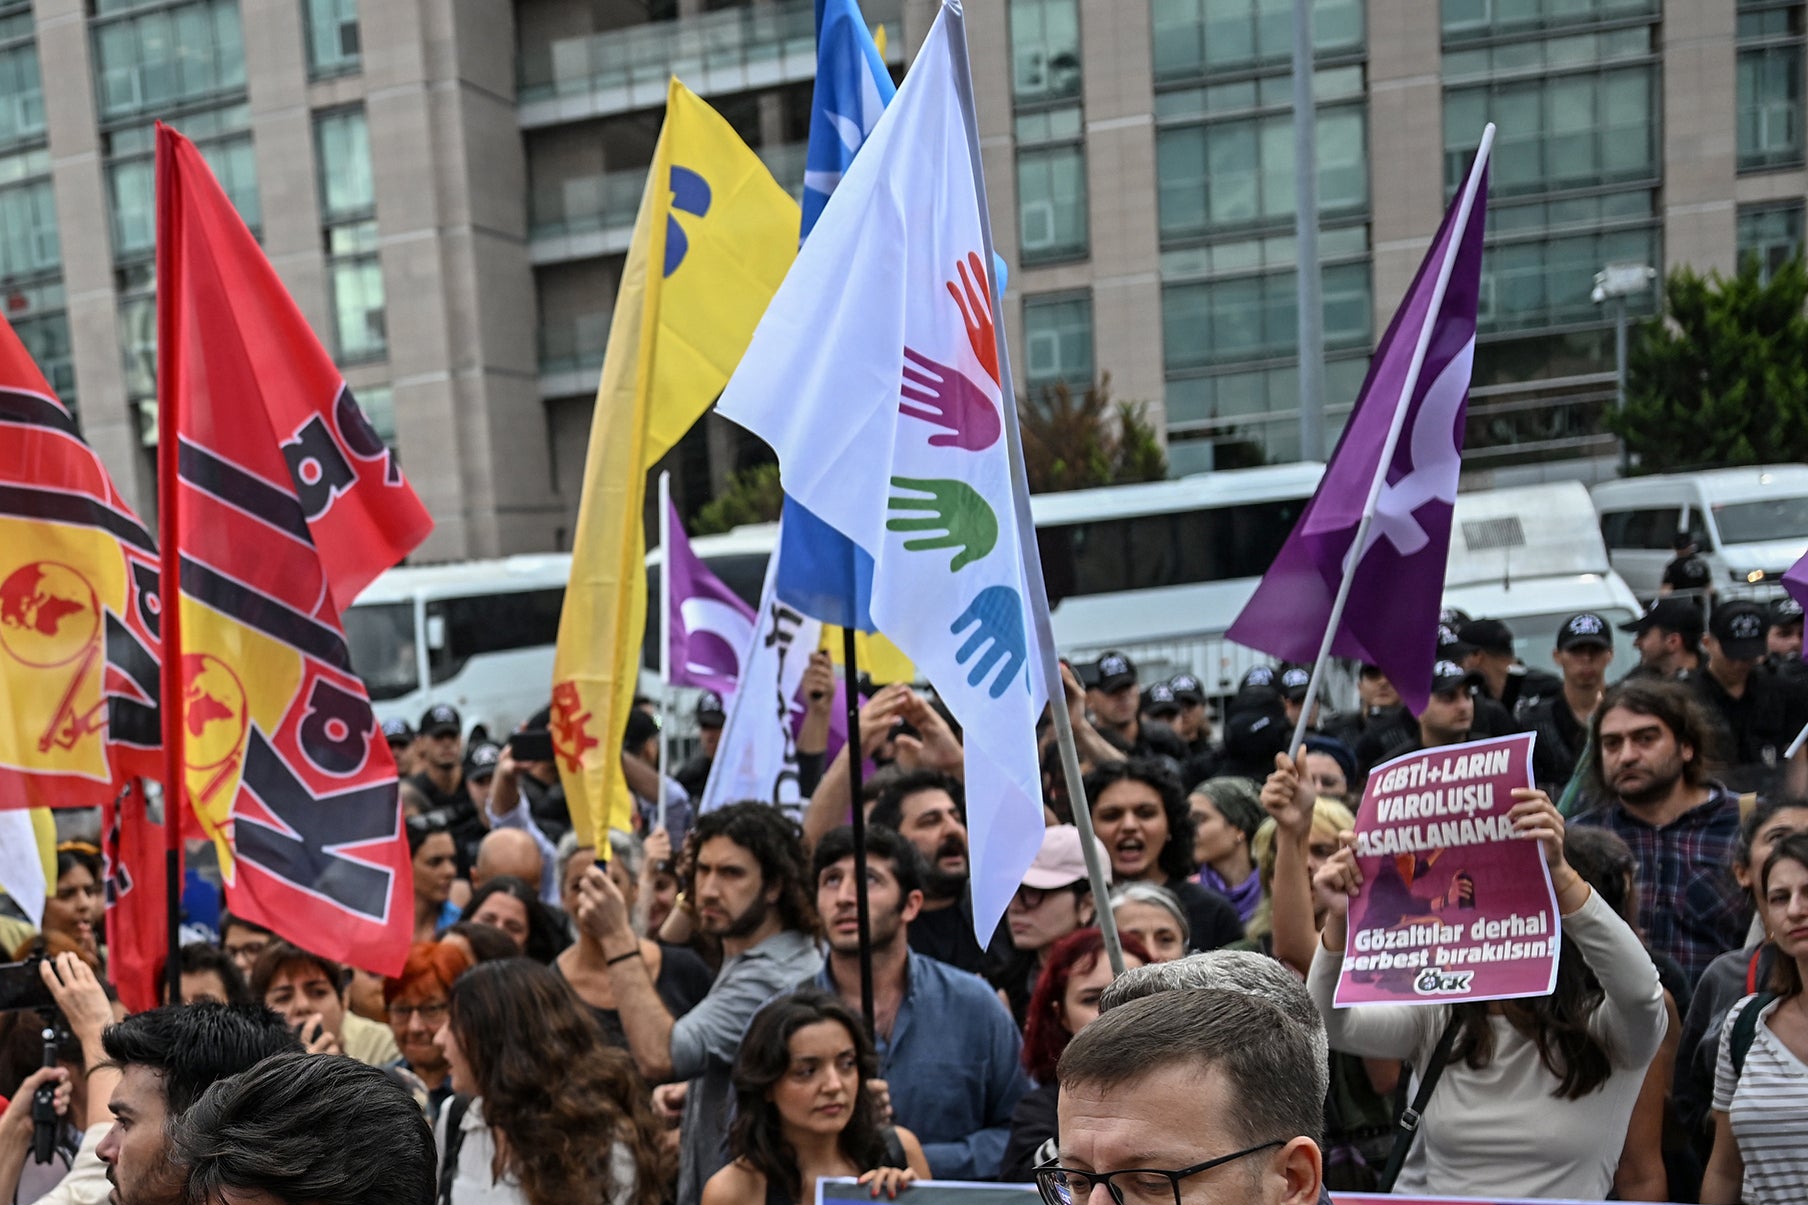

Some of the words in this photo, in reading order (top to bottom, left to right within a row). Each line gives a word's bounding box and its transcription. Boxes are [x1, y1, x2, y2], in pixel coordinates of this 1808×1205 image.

[1372, 748, 1510, 798] LGBTİ+LARIN
[1377, 782, 1494, 824] VAROLUŞU
[1356, 815, 1526, 858] ASAKLANAMA
[1355, 921, 1465, 952] Gözaltılar
[1471, 910, 1548, 941] derhal
[1343, 949, 1429, 972] serbest
[1434, 936, 1554, 967] bırakılsın!
